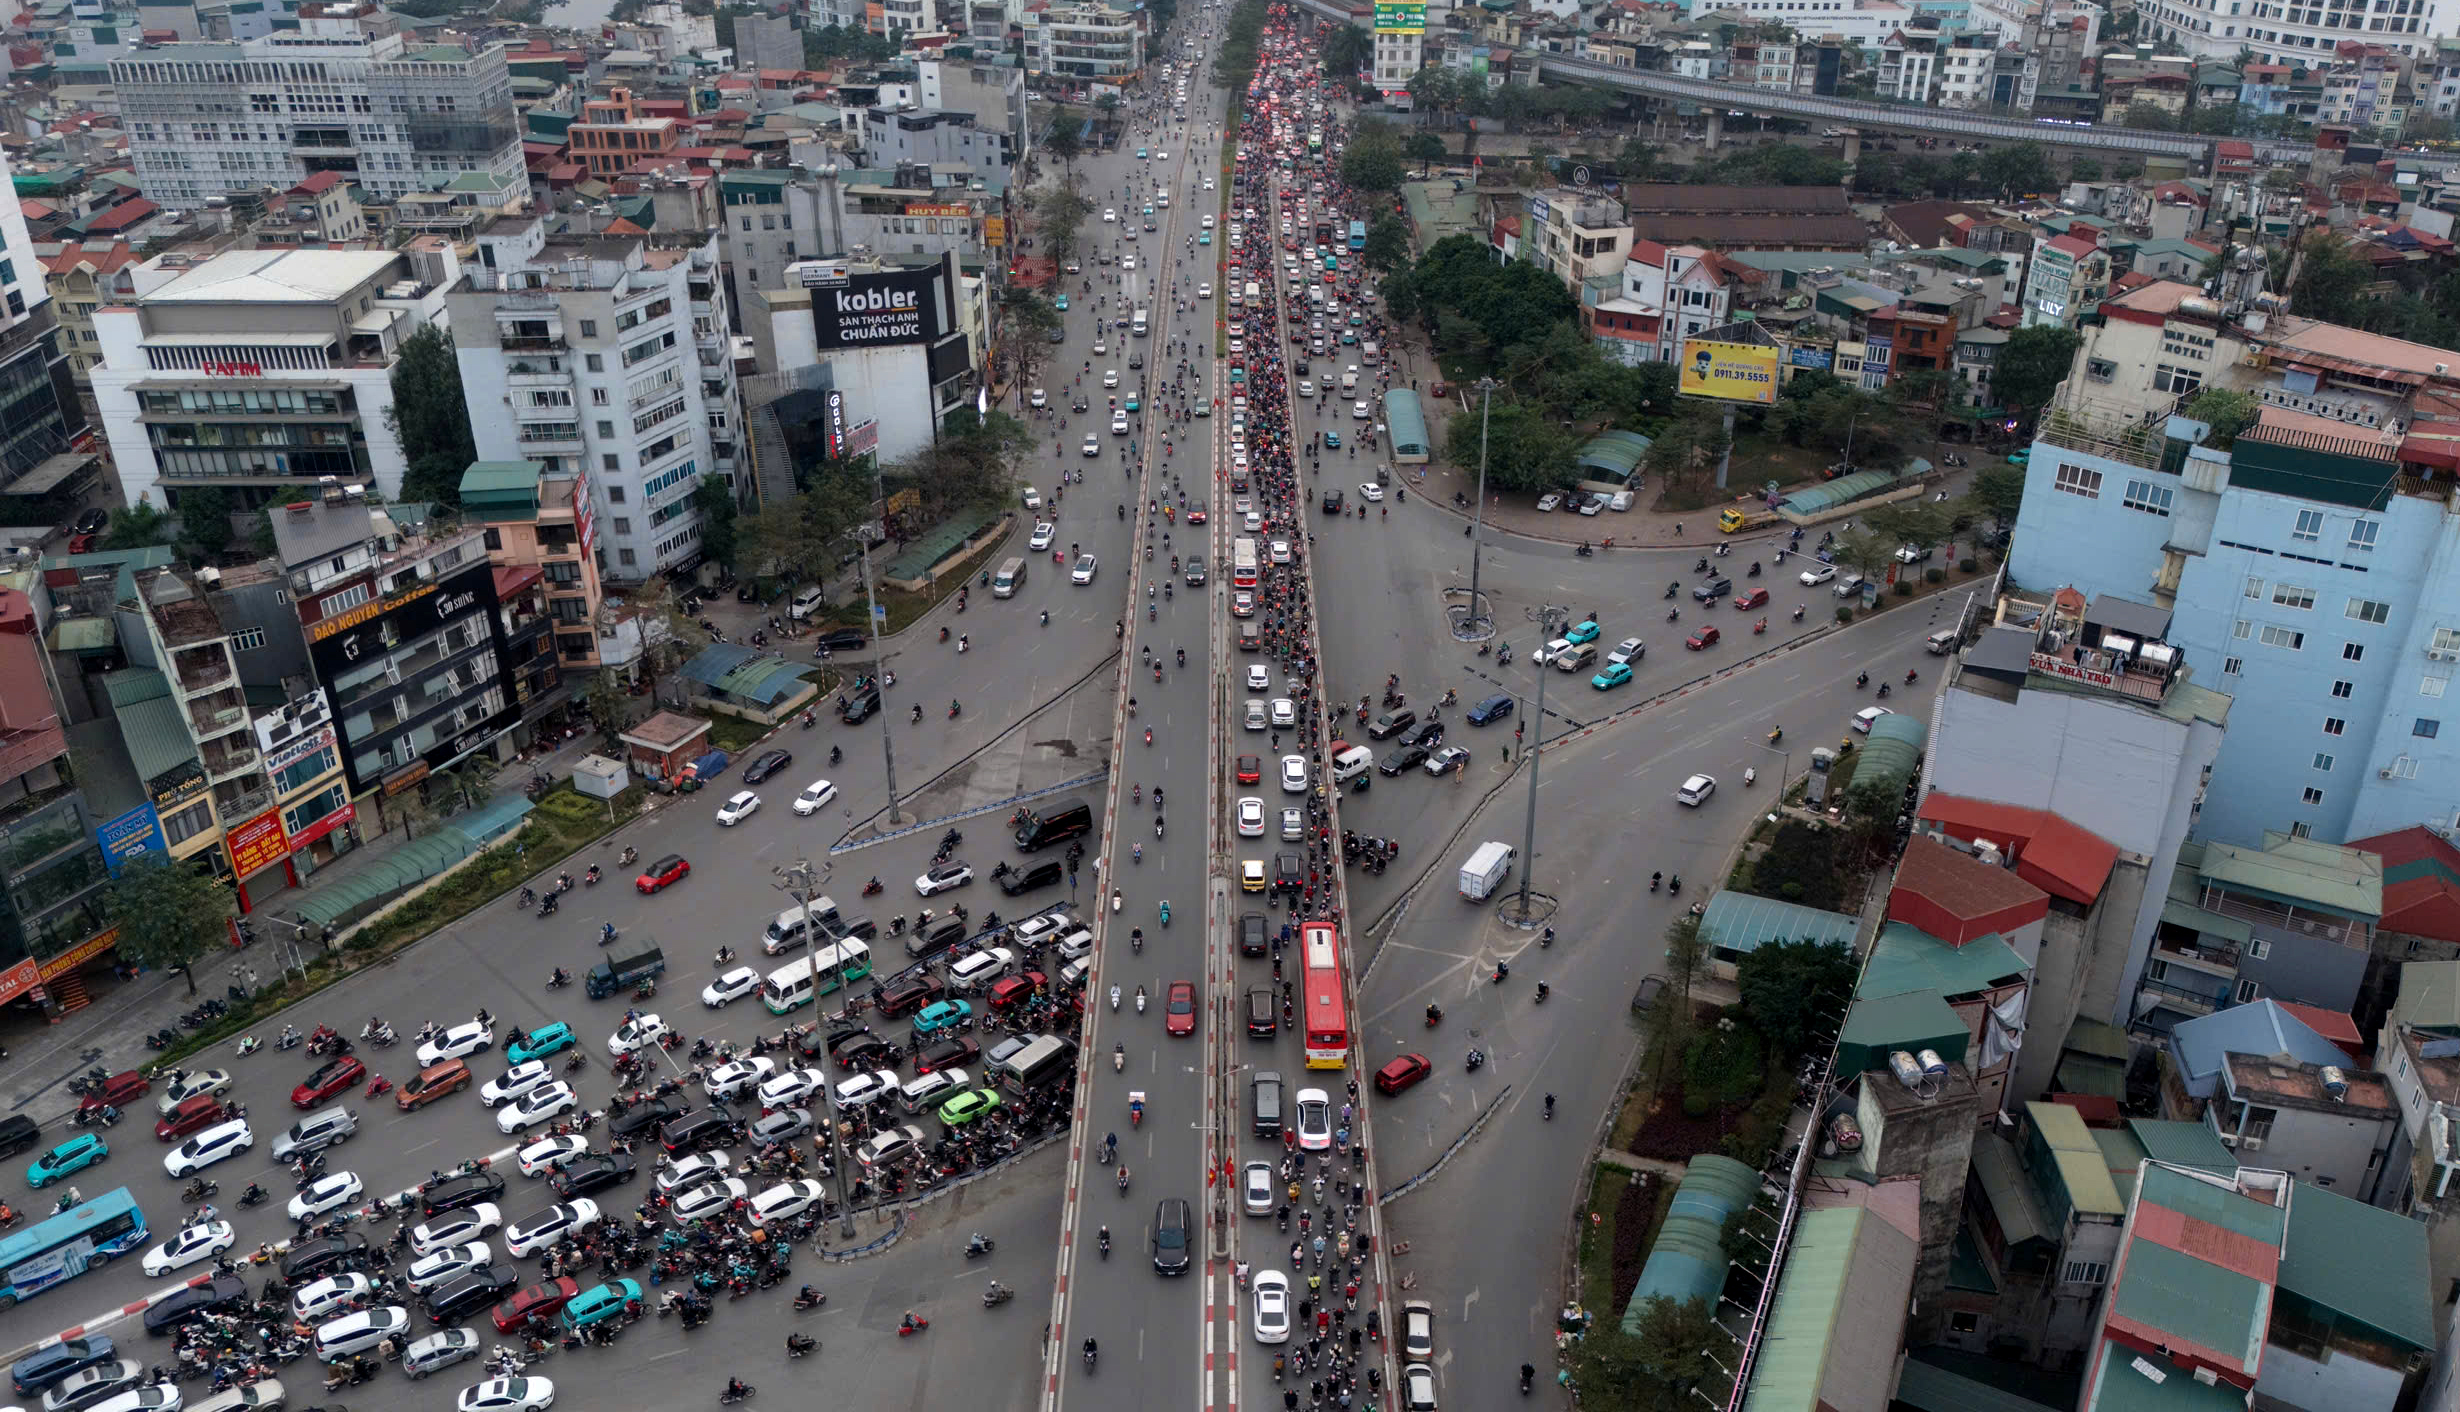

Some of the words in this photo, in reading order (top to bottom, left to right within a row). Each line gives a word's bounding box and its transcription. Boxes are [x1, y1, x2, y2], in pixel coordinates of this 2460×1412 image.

[836, 286, 916, 312] kobler
[2040, 299, 2063, 316] LILY
[839, 315, 859, 326] SÀN
[861, 314, 895, 326] THẠCH
[898, 312, 918, 322] ANH
[841, 322, 888, 340] CHUẨN
[890, 323, 919, 337] ĐỨC
[2165, 343, 2203, 360] HOTEL
[1714, 369, 1769, 382] 0911.39.5555
[383, 583, 438, 611] Coffee
[454, 591, 475, 610] SHINE
